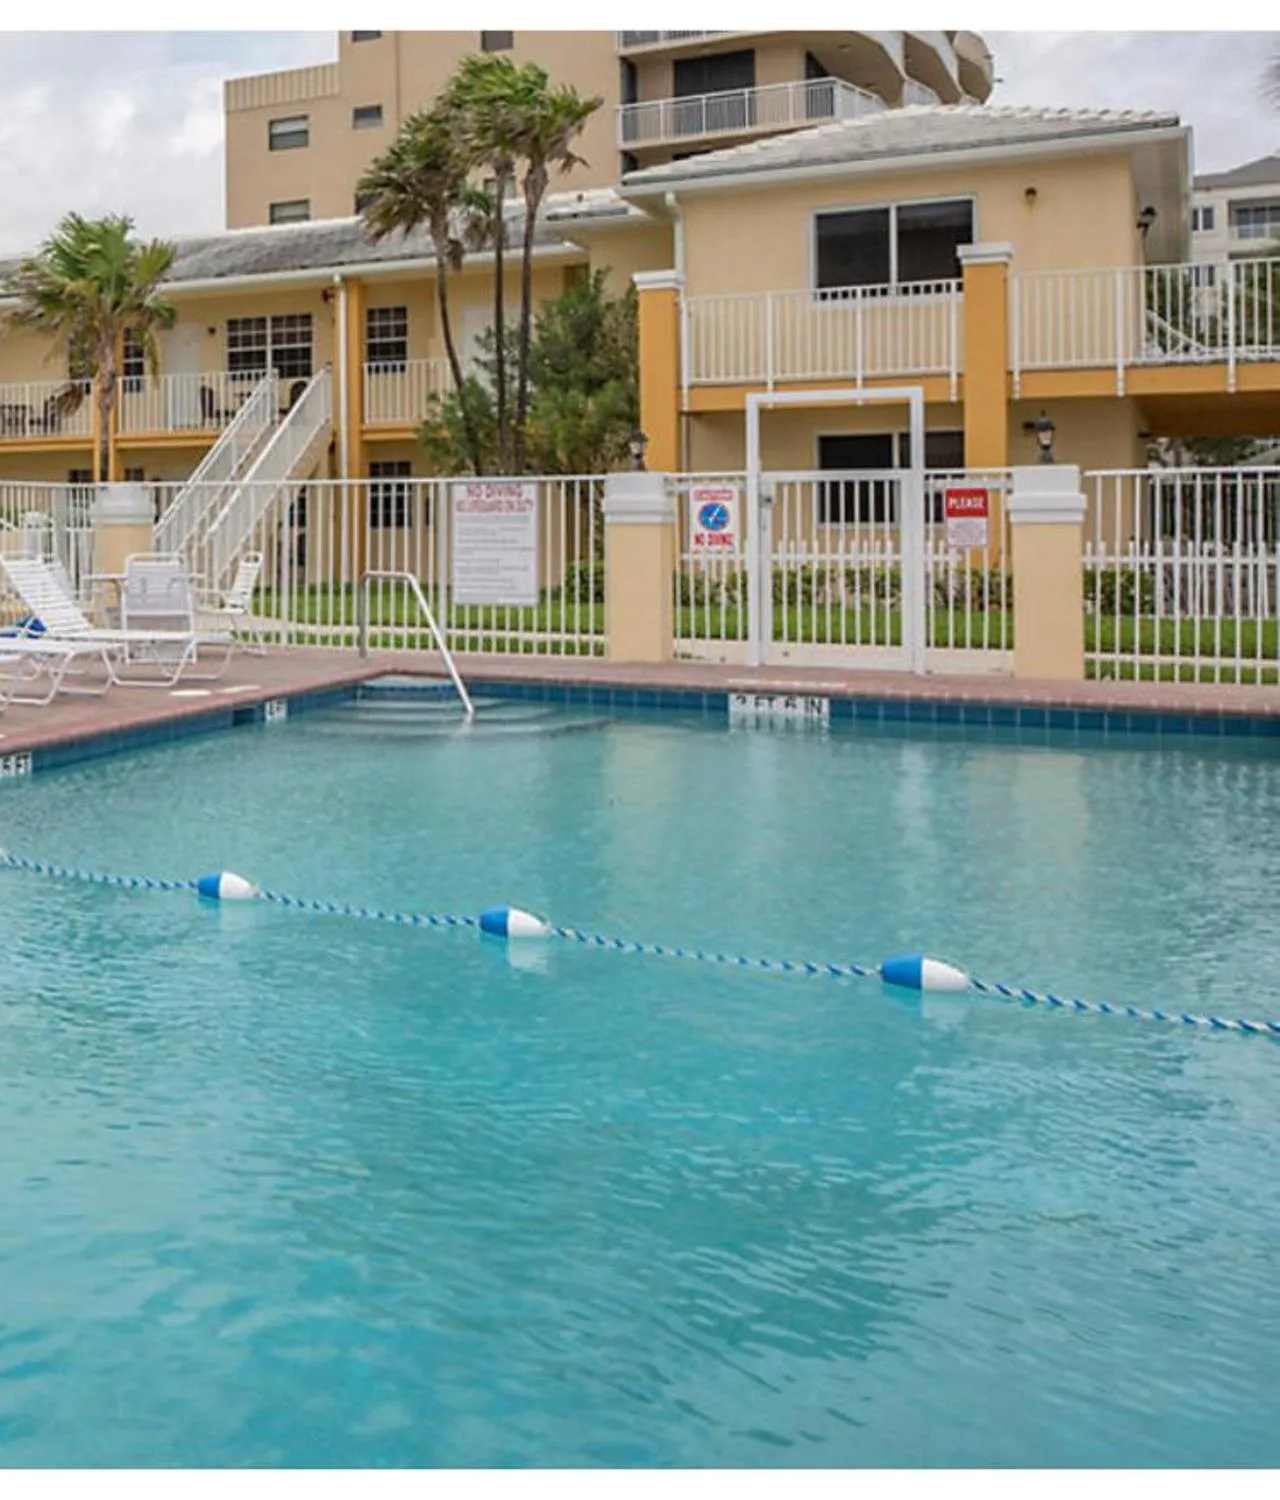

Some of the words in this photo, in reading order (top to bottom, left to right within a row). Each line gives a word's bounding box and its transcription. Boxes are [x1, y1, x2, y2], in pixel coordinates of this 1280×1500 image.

[467, 483, 481, 498] NO
[486, 483, 523, 498] DIVING
[948, 497, 985, 509] PLEASE
